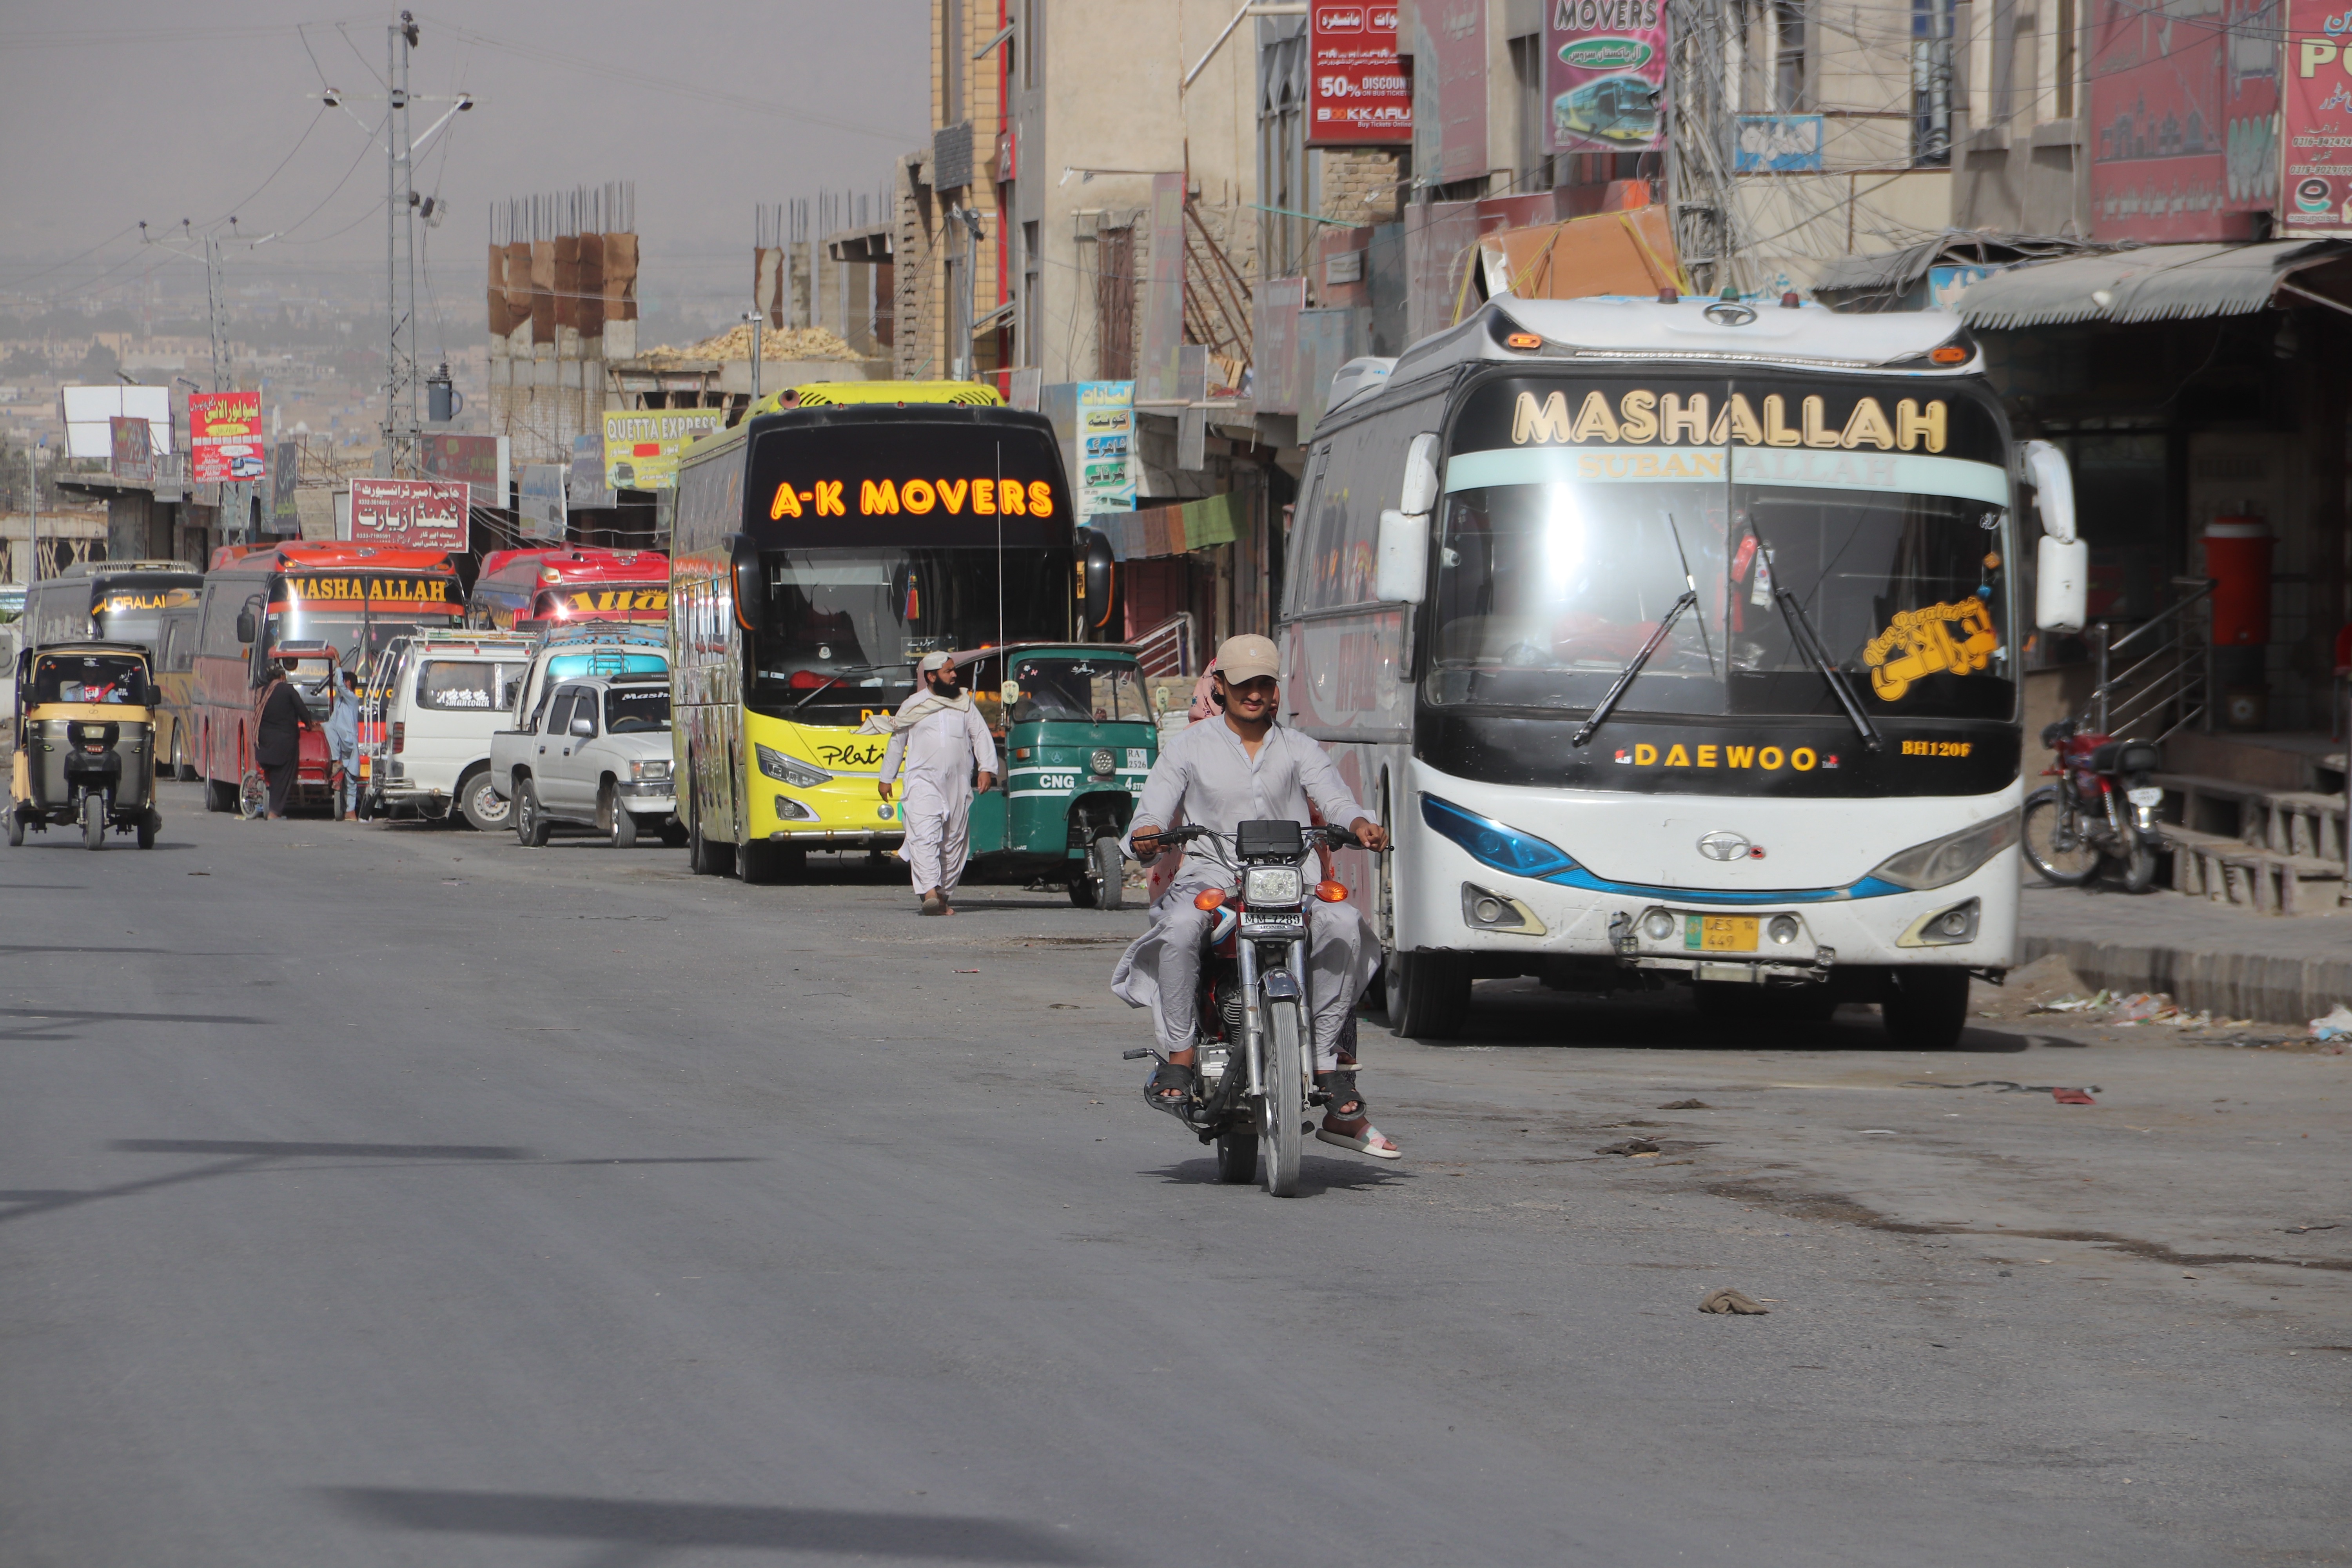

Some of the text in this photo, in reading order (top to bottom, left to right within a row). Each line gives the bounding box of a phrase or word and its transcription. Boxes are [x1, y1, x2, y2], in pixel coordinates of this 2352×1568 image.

[1553, 0, 1658, 31] MOVERS
[1320, 76, 1413, 98] 50% DISCOUNT
[606, 418, 660, 442] QUETTA
[1735, 450, 1896, 486] ALLAH
[771, 479, 1053, 520] A-K MOVERS
[285, 578, 446, 602] MASHA ALLAH
[103, 594, 165, 612] LORALAI
[1128, 749, 1140, 757] RA
[1635, 744, 1817, 771] DAEWOO
[1901, 740, 1971, 757] BH120F
[1129, 760, 1147, 768] 2526
[1040, 775, 1075, 789] CNG
[1125, 777, 1132, 791] 4
[1244, 914, 1301, 925] MM-7289
[1705, 918, 1733, 931] LES
